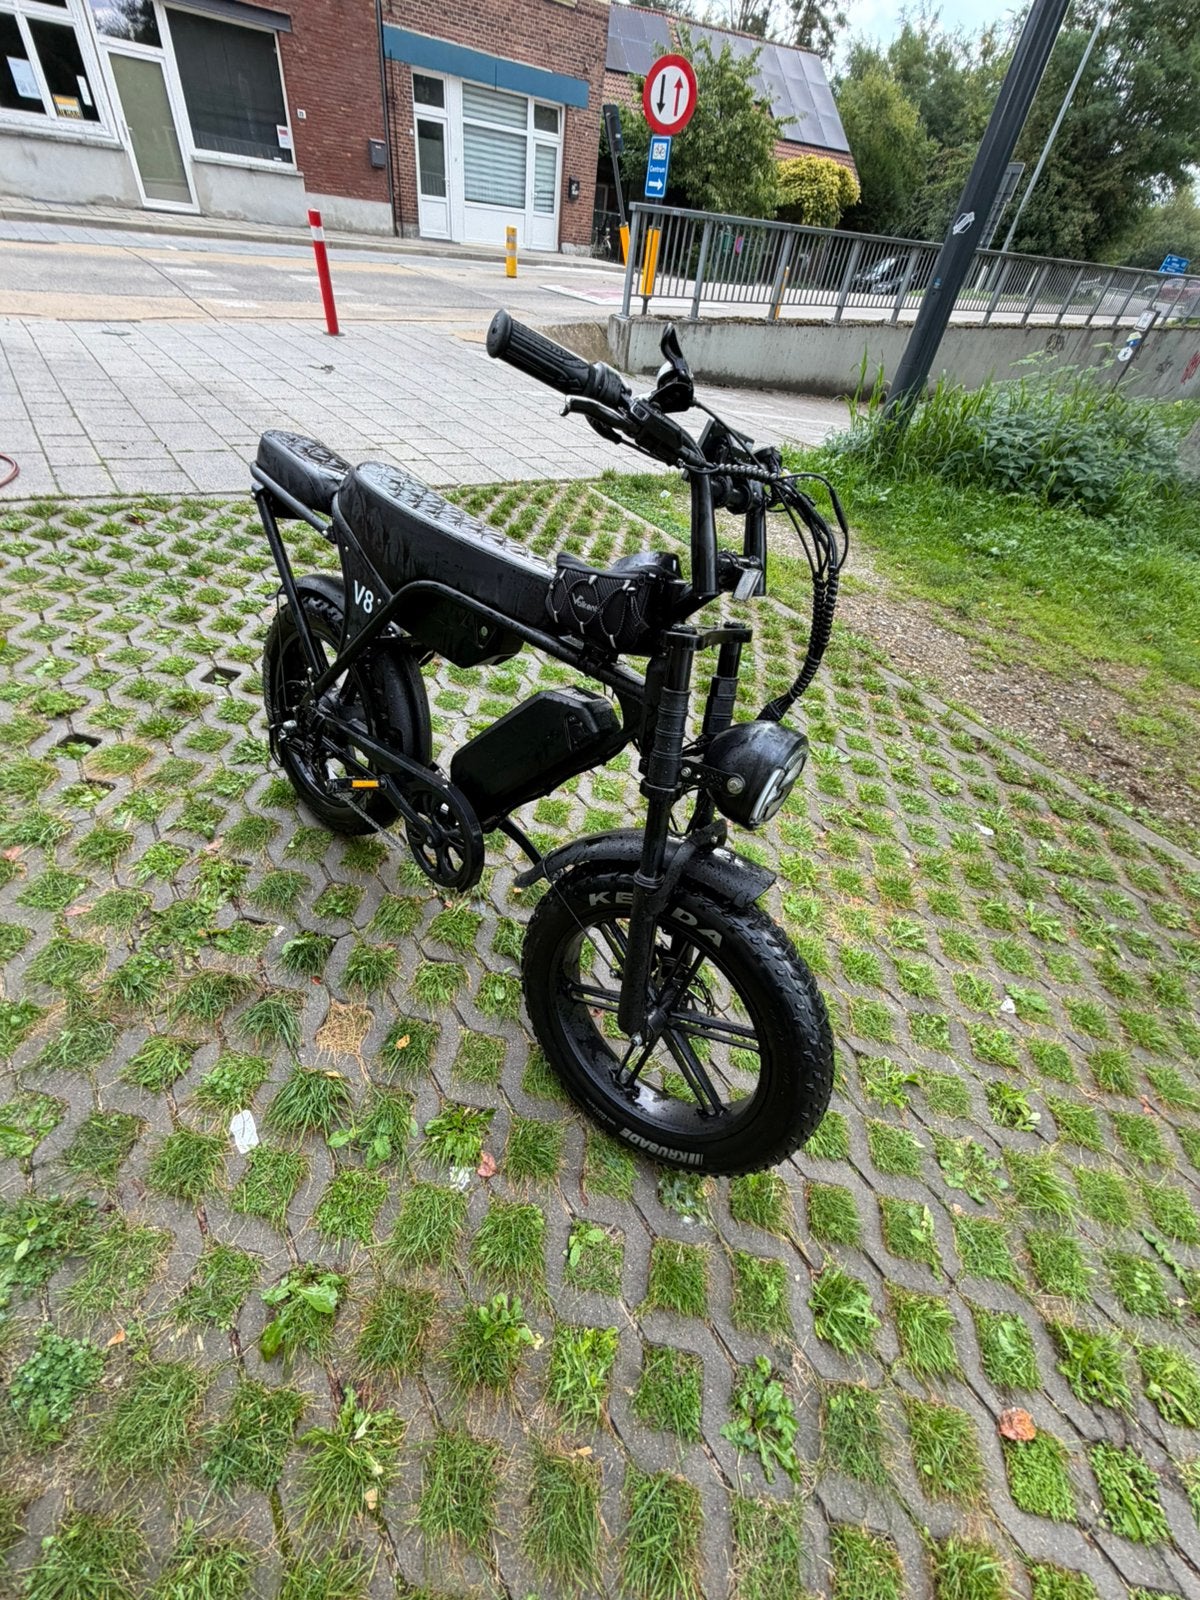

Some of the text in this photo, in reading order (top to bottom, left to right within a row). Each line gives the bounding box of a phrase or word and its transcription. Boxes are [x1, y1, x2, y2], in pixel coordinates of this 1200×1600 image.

[650, 165, 665, 173] Centrum
[354, 579, 374, 614] V8
[588, 891, 723, 948] KEDA
[619, 1127, 688, 1163] KRUSADE
